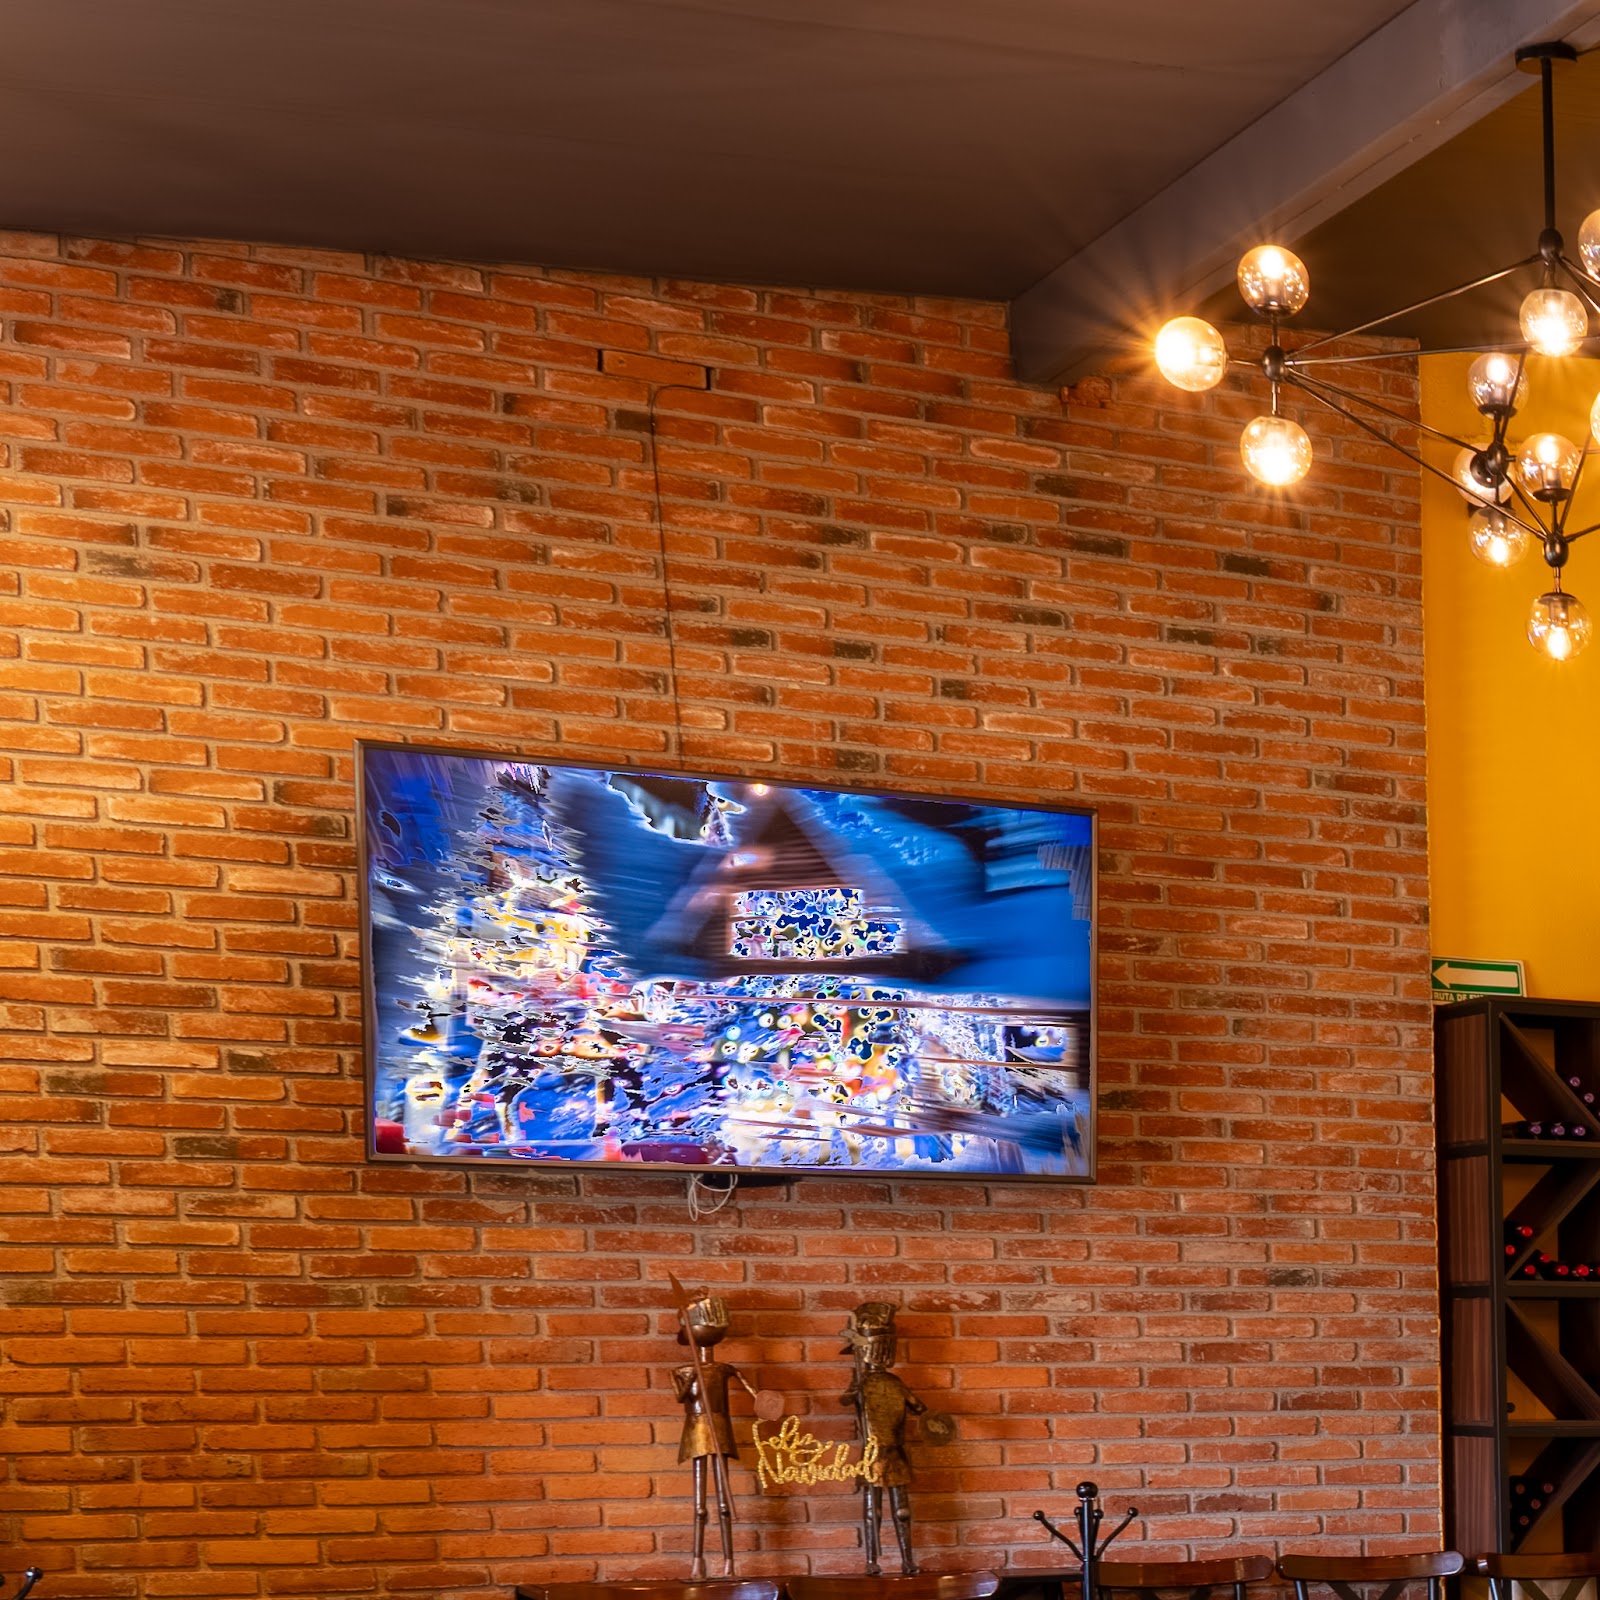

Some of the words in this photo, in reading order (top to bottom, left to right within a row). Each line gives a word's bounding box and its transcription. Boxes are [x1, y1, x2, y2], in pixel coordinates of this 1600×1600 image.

[1433, 992, 1454, 1001] RUTA
[753, 1415, 834, 1465] Feliz
[757, 1435, 879, 1489] Navidad
